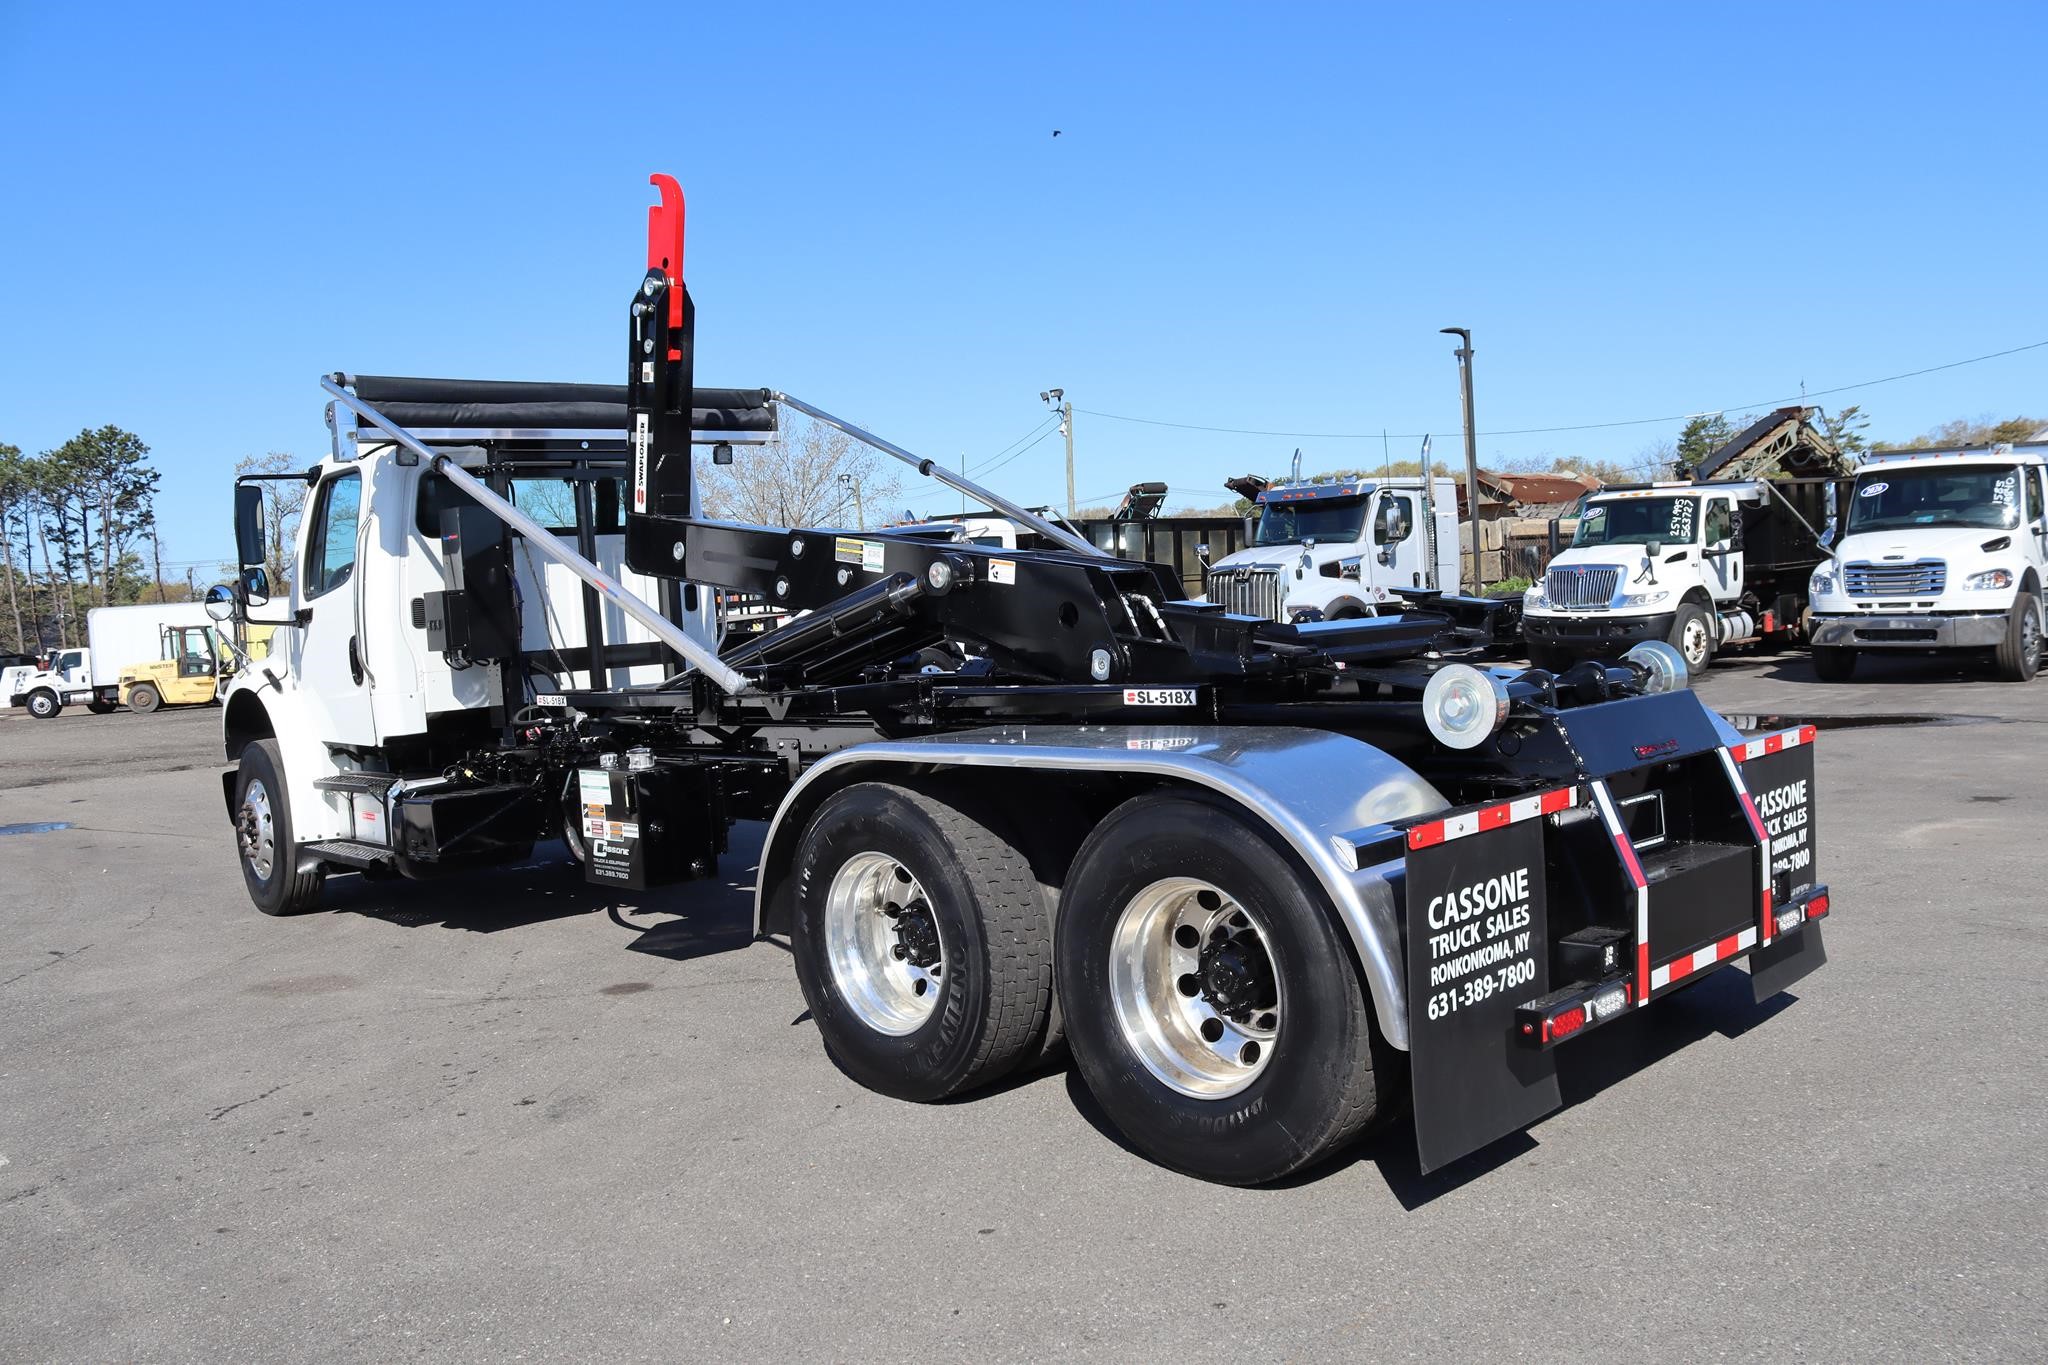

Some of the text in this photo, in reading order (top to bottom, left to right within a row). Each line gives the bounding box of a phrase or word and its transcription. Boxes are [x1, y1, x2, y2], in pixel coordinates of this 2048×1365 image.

[638, 422, 646, 487] SWAPLOADER
[1681, 499, 1694, 538] 563727
[1991, 479, 2005, 504] 1585
[1783, 806, 1808, 831] SALES
[1798, 827, 1808, 845] NY
[1428, 868, 1529, 930] CASSONE
[1429, 904, 1531, 959] TRUCK SALES
[1430, 931, 1531, 987] RONKONKOMA, NY
[1428, 958, 1536, 1021] 631-389-7800
